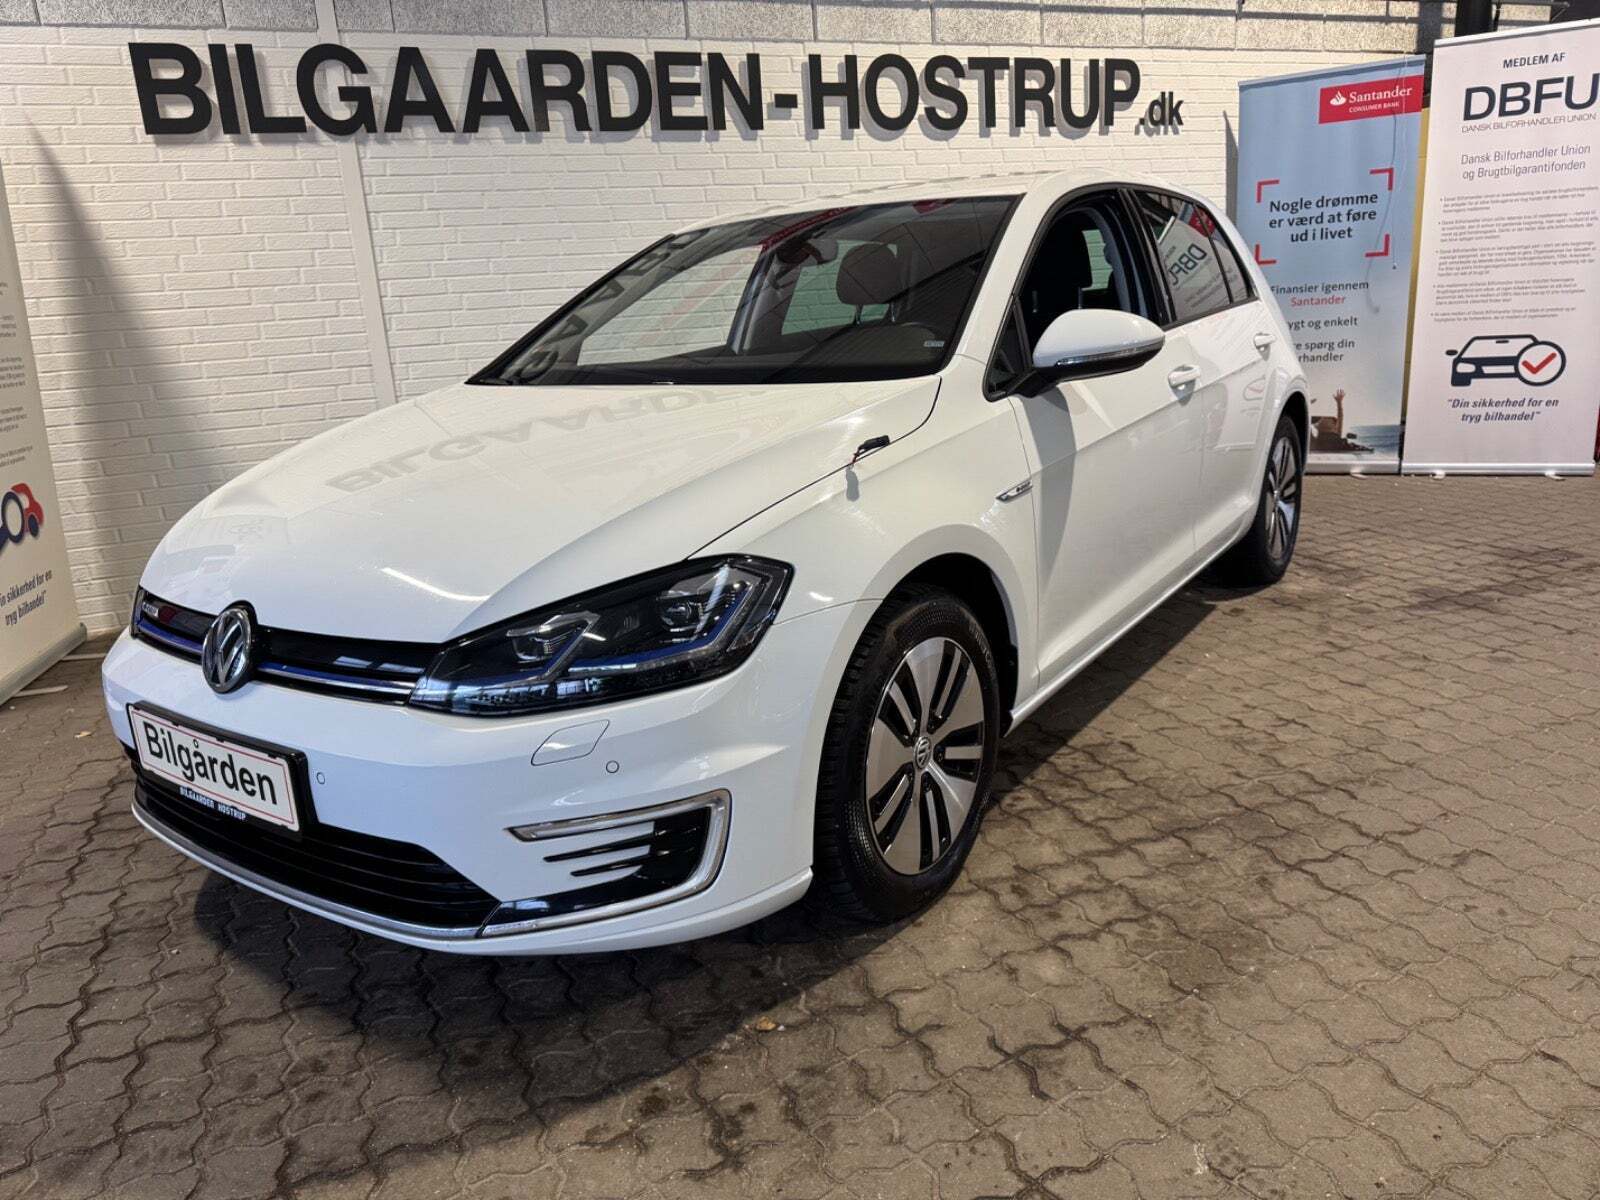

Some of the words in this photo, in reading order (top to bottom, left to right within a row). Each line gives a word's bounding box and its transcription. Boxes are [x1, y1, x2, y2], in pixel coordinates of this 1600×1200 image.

[1503, 55, 1549, 69] MEDLEM
[1551, 52, 1566, 63] AF
[1349, 85, 1412, 103] Santander
[1463, 73, 1600, 121] DBFU
[1349, 103, 1382, 113] CONSUMER
[1383, 101, 1400, 109] BANK
[1461, 124, 1492, 133] DANSK
[1493, 116, 1566, 130] BILFORHANDLER
[1567, 112, 1597, 122] UNION
[1461, 153, 1490, 165] Dansk
[1493, 148, 1558, 162] Bilforhandler
[1560, 144, 1591, 156] Union
[1462, 170, 1475, 181] og
[1477, 160, 1586, 179] Brugtbilgarantifonden
[1269, 196, 1312, 214] Nogle
[1315, 193, 1378, 209] drømme
[1269, 217, 1284, 228] er
[1287, 212, 1324, 227] værd
[1327, 213, 1342, 224] at
[1346, 208, 1377, 222] føre
[1290, 229, 1308, 243] ud
[1320, 226, 1353, 240] livet
[1321, 280, 1369, 294] igennem
[1290, 295, 1346, 307] Santander
[1307, 318, 1322, 329] og
[1324, 316, 1358, 328] enkelt
[1305, 339, 1335, 351] spørg
[1337, 338, 1355, 348] din
[1298, 352, 1344, 362] rhandler
[1471, 397, 1525, 408] sikkerhed
[1527, 397, 1543, 407] for
[1545, 399, 1560, 407] en
[1461, 413, 1481, 424] tryg
[143, 721, 278, 805] Bilgården
